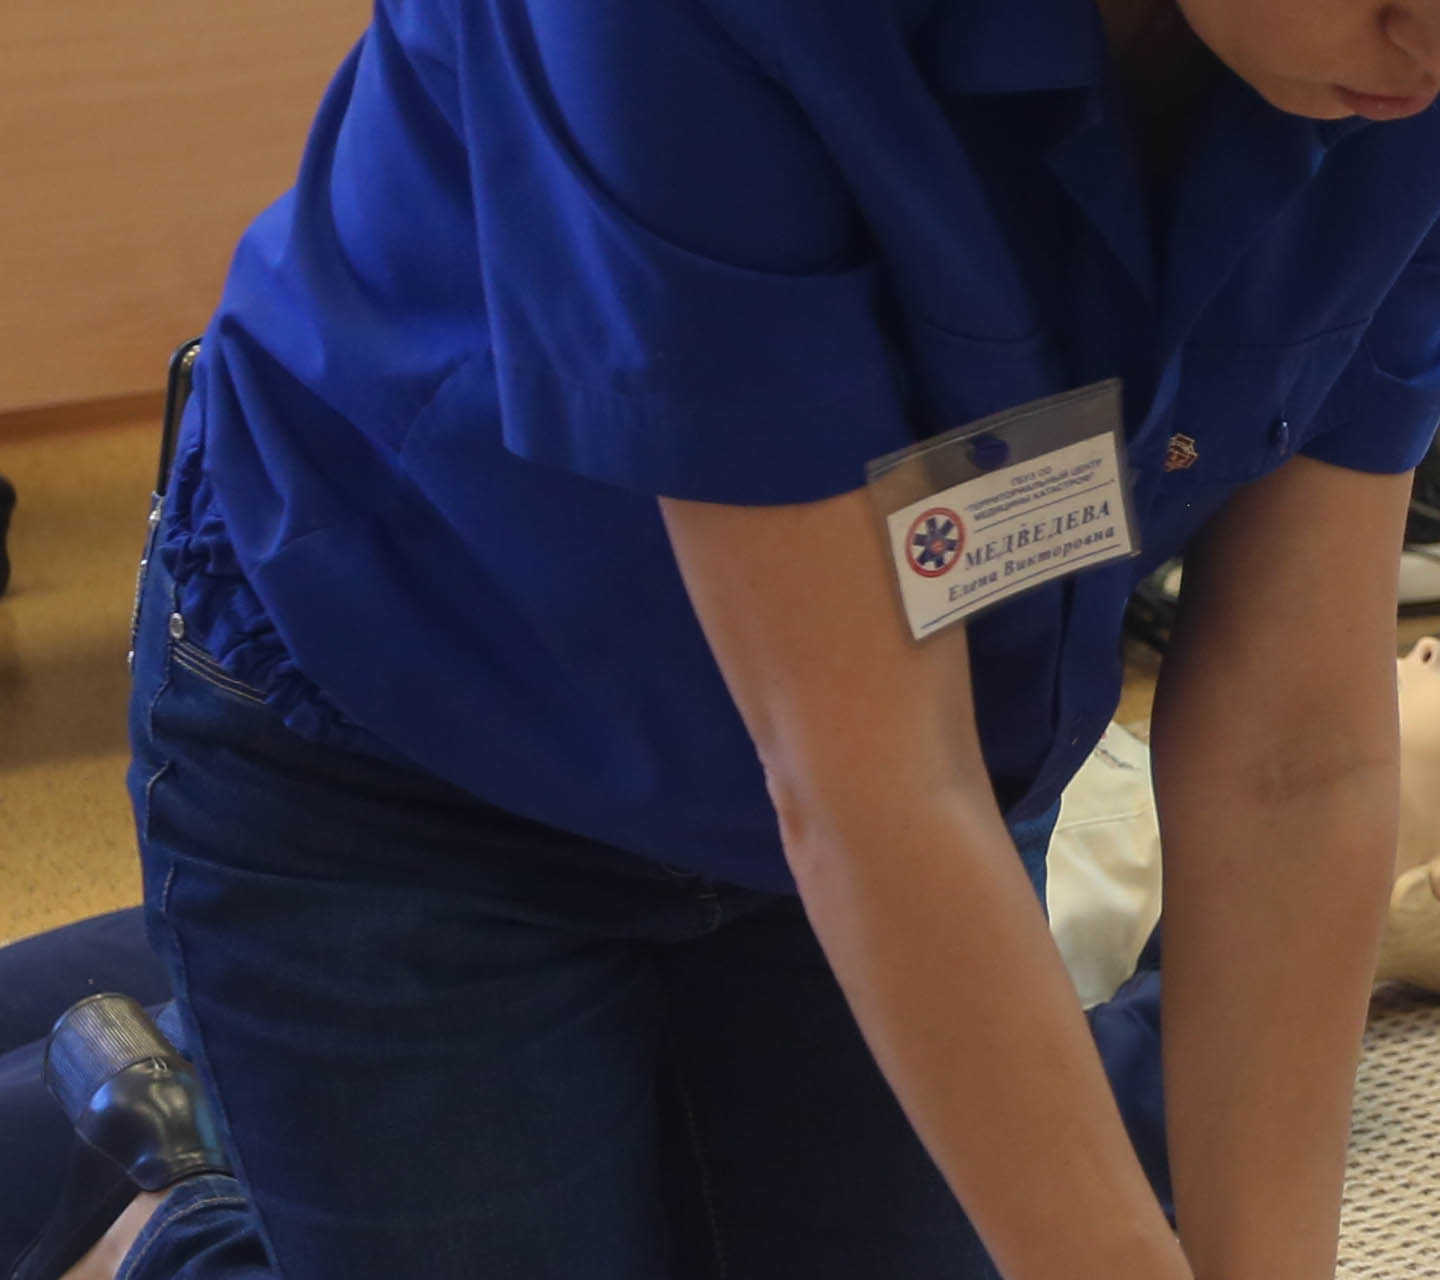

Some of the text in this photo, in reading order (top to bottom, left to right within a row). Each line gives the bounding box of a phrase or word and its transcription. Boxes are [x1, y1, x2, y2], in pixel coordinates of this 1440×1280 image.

[947, 526, 1116, 602] Елена Викторовна
[964, 500, 1110, 570] МЕДВЕДЕВА
